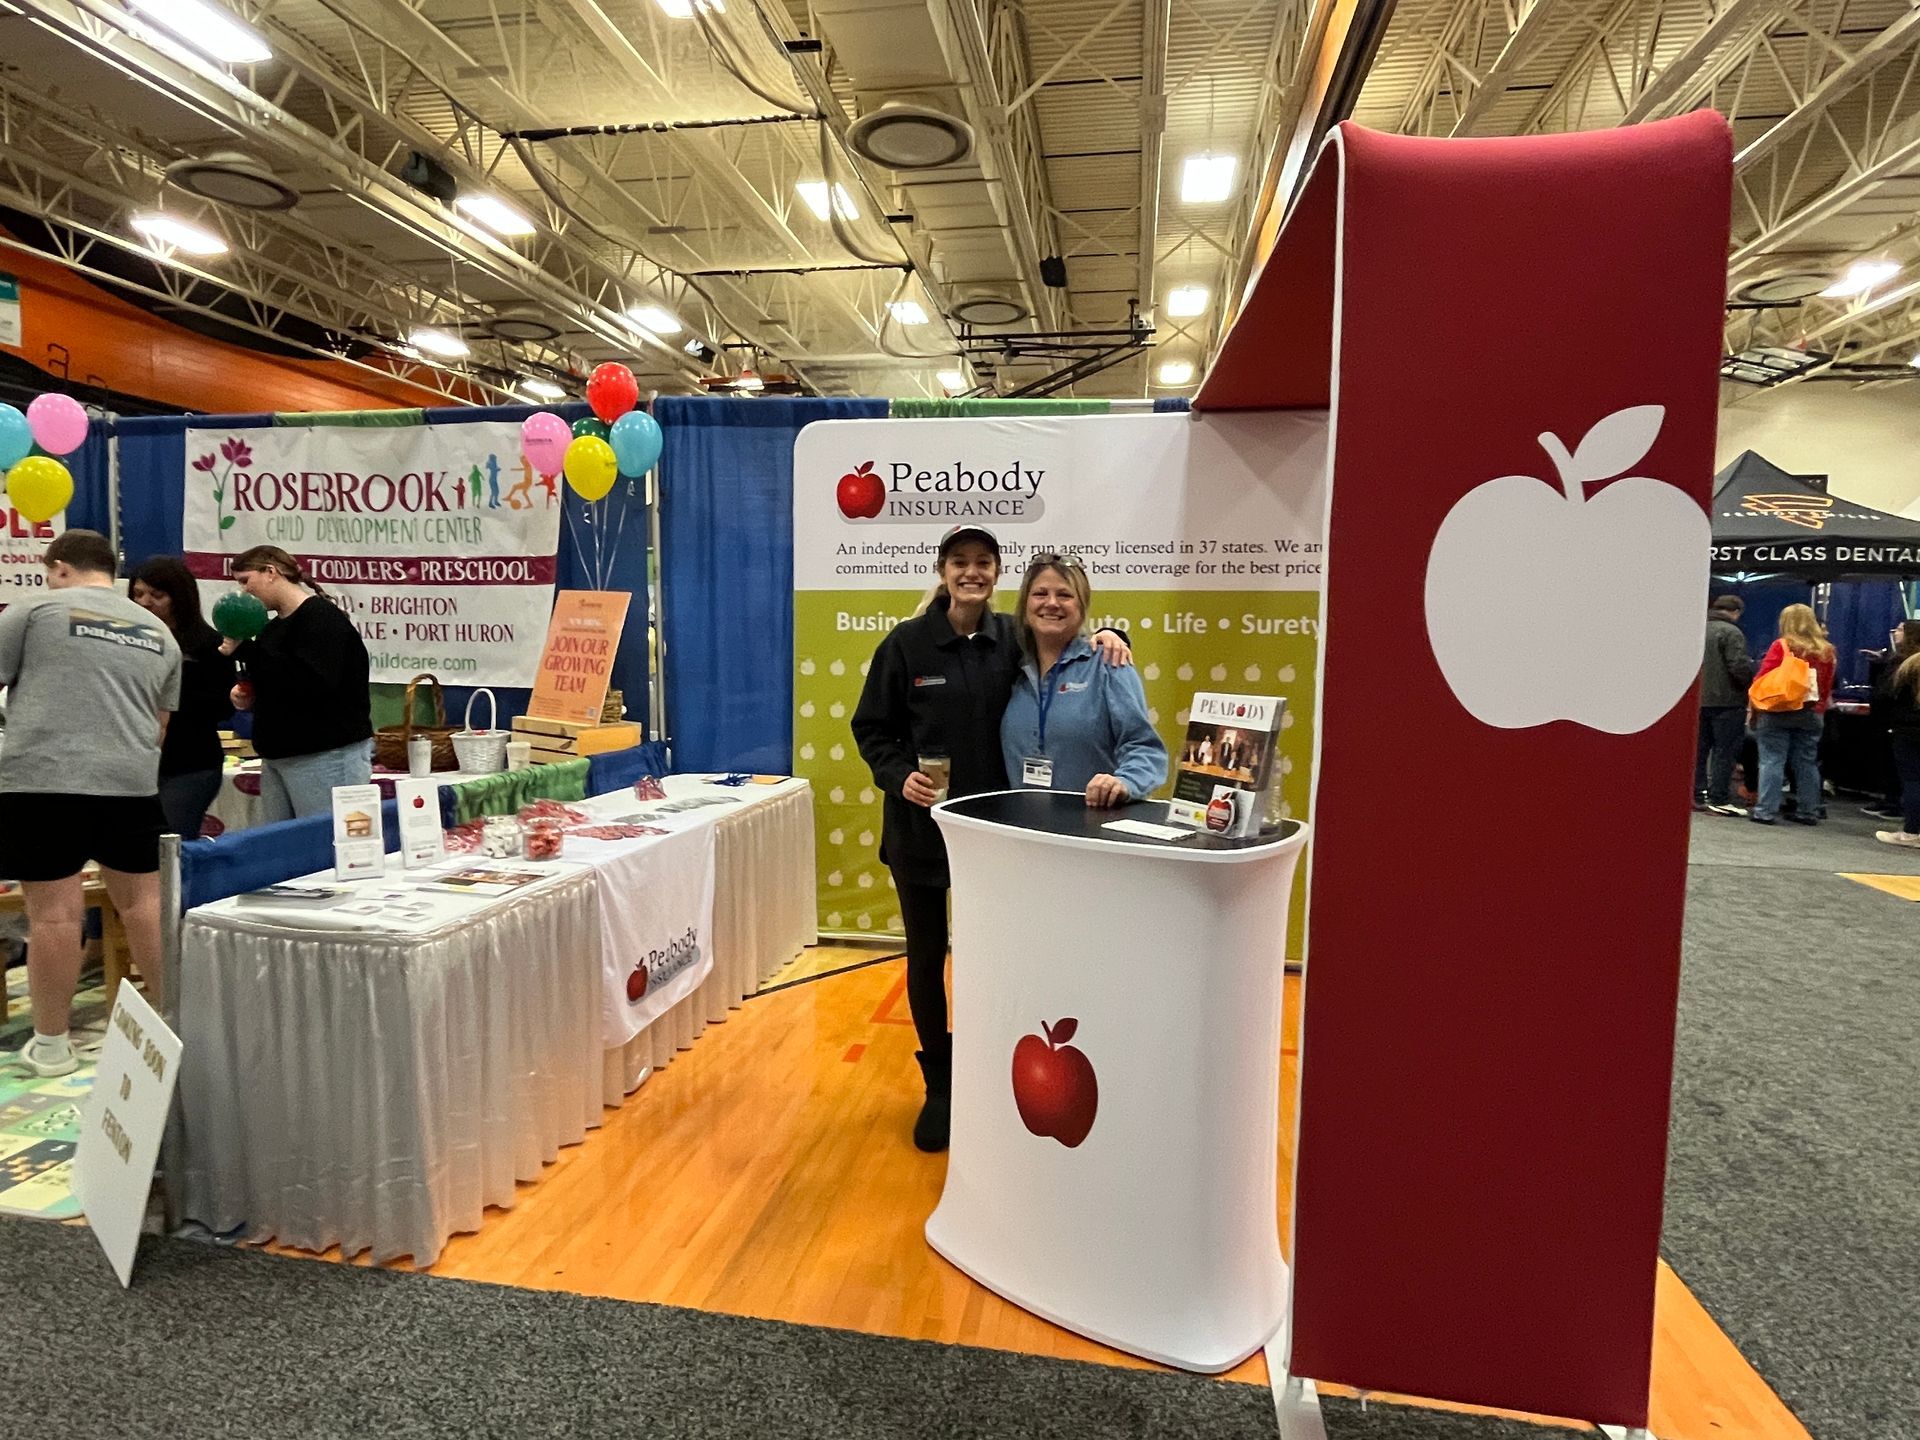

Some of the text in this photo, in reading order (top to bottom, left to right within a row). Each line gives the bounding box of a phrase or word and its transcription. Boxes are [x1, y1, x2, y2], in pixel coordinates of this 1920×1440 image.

[888, 460, 1046, 500] Peabody
[233, 471, 451, 513] ROSEBROOK
[889, 499, 1025, 517] INSURANCE
[266, 515, 483, 544] CHILD DEVELOPMENT CENTER
[836, 541, 857, 555] An
[861, 541, 941, 558] independen
[999, 541, 1025, 557] mily
[1031, 543, 1055, 555] run
[1060, 542, 1110, 557] agency
[1115, 540, 1174, 554] licensed
[1179, 540, 1194, 554] in
[1199, 540, 1218, 554] 37
[1222, 541, 1268, 554] states.
[1274, 539, 1299, 553] We
[1708, 546, 1747, 561] RST
[1753, 546, 1827, 561] CLASS
[307, 558, 536, 582] TODDLERS PRESCHOOL
[836, 560, 908, 575] committed
[914, 563, 927, 575] to
[1092, 560, 1121, 575] best
[1126, 564, 1190, 577] coverage
[1195, 560, 1217, 575] for
[1221, 560, 1246, 575] the
[1250, 560, 1280, 575] best
[371, 596, 458, 616] BRIGHTON
[836, 610, 904, 632] Busin
[1089, 614, 1131, 633] uto
[1163, 612, 1208, 634] Life
[75, 624, 161, 652] patagonia
[405, 622, 450, 642] PORT
[455, 623, 515, 643] HURON
[550, 636, 609, 656] JOIN OUR
[369, 652, 477, 671] hildcare.com
[544, 654, 607, 676] GROWING
[554, 674, 587, 694] TEAM
